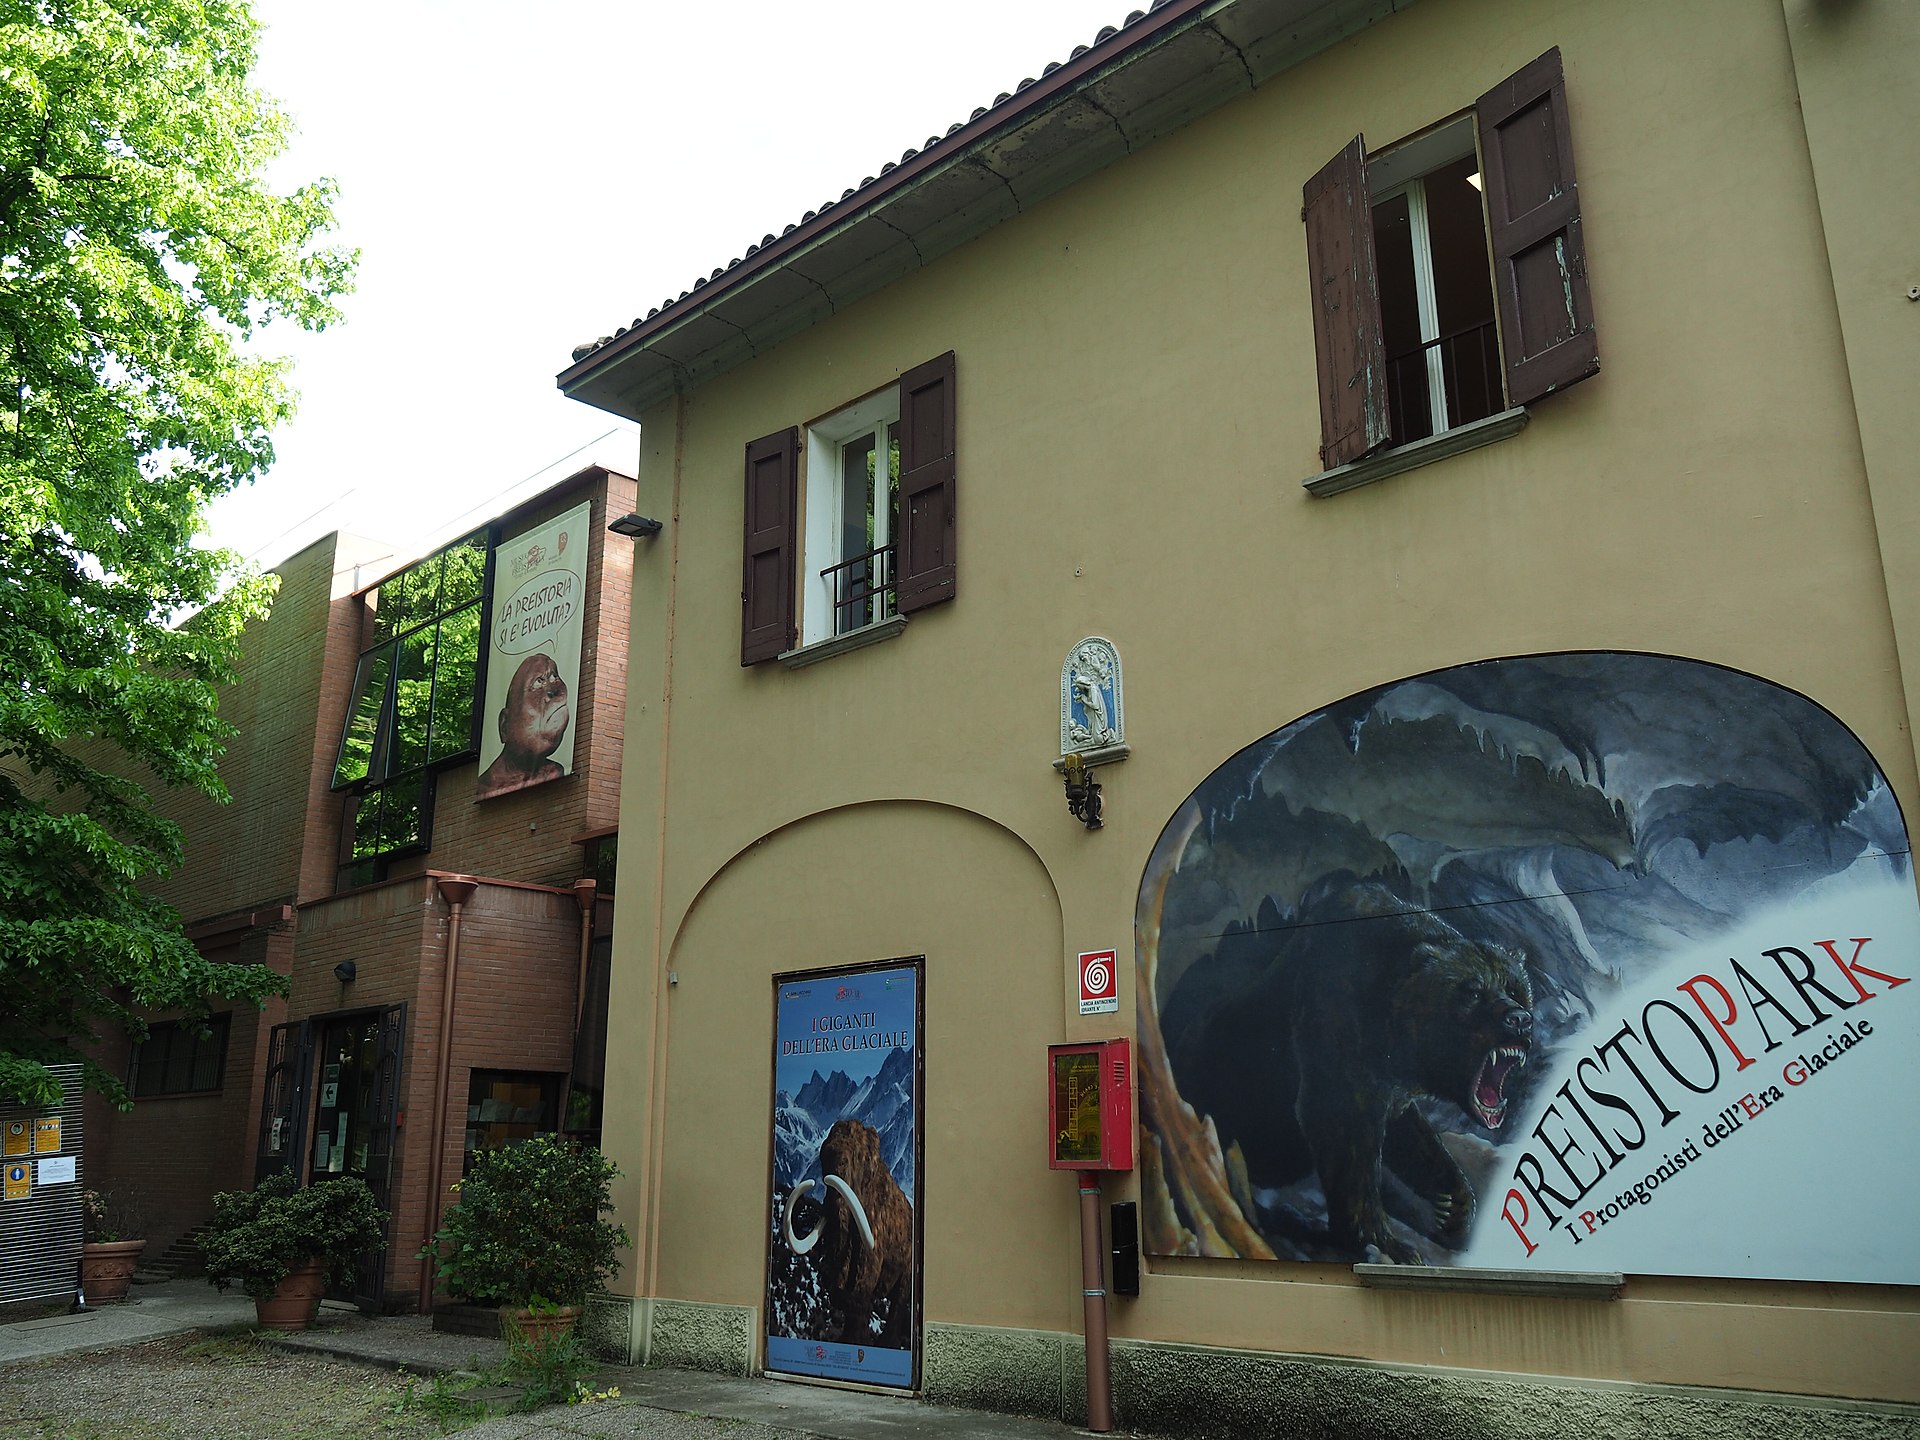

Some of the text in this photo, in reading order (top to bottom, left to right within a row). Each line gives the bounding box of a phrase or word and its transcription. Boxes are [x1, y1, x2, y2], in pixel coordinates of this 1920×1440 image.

[501, 577, 572, 623] LA PREISTORIA
[499, 602, 571, 648] SI E' EVOLUTA?
[783, 1030, 909, 1056] DELL'ERA GLACIALE
[811, 1012, 876, 1034] I GIGANTI
[1500, 937, 1912, 1258] PREISTOPARK
[1563, 1016, 1874, 1245] I Protagonisti dell'Era Glaciale
